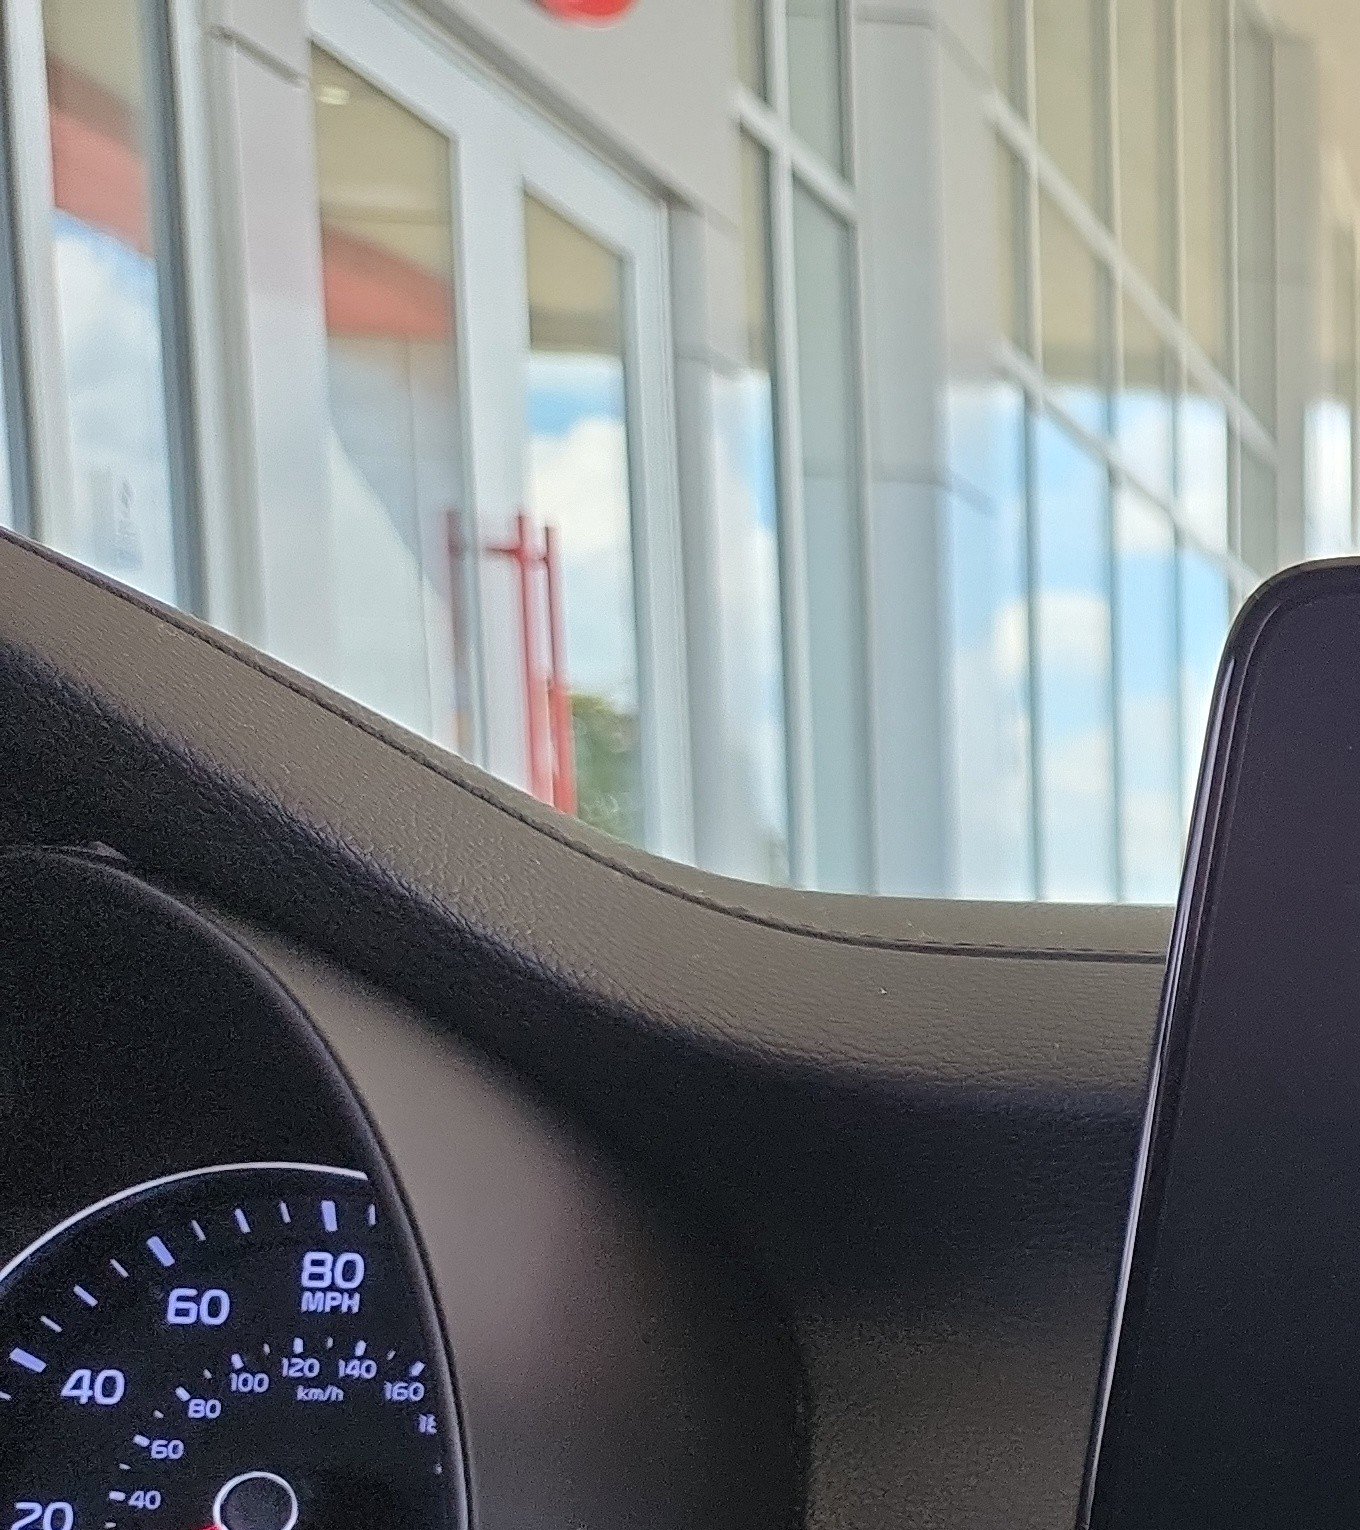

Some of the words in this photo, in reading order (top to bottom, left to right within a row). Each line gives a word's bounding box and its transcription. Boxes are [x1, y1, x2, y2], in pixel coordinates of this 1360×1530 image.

[301, 1251, 365, 1289] 80
[166, 1287, 230, 1326] 60
[301, 1290, 360, 1313] MPH
[282, 1357, 320, 1378] 120
[338, 1358, 377, 1379] 140
[60, 1368, 125, 1405] 40
[230, 1372, 270, 1393] 100
[296, 1385, 344, 1401] km/h
[384, 1381, 425, 1402] 160
[187, 1398, 222, 1419] 80
[150, 1439, 185, 1460] 60
[127, 1490, 162, 1510] 40
